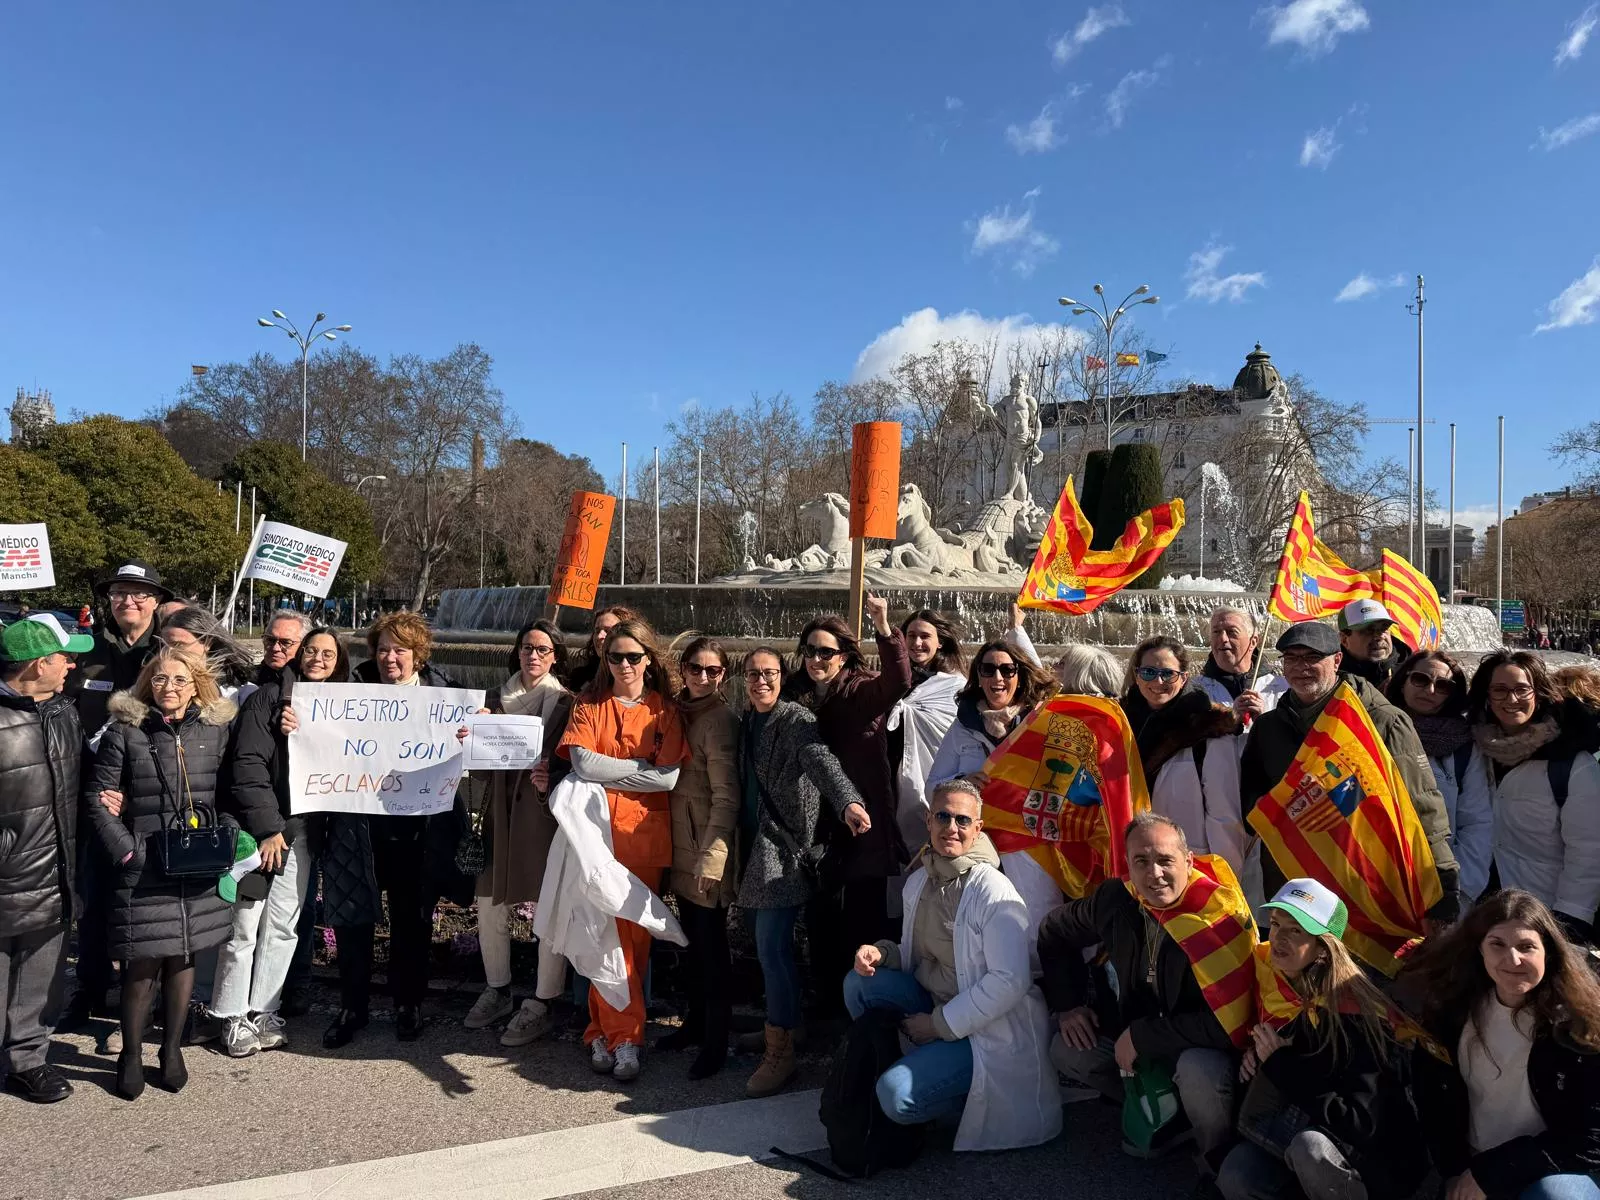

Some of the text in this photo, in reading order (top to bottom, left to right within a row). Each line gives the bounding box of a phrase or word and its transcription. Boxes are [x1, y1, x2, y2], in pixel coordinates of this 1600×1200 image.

[586, 497, 605, 510] NOS
[262, 533, 336, 562] SINDICATO MÉDICO
[255, 543, 331, 577] CESM
[1, 572, 38, 580] Mancha
[254, 562, 290, 578] Castilla-La
[291, 572, 319, 587] Mancha
[575, 567, 591, 580] TOCA
[311, 698, 409, 723] NUESTROS
[344, 738, 445, 760] NO SON
[305, 773, 403, 796] ESCLAVOS
[419, 780, 431, 794] de
